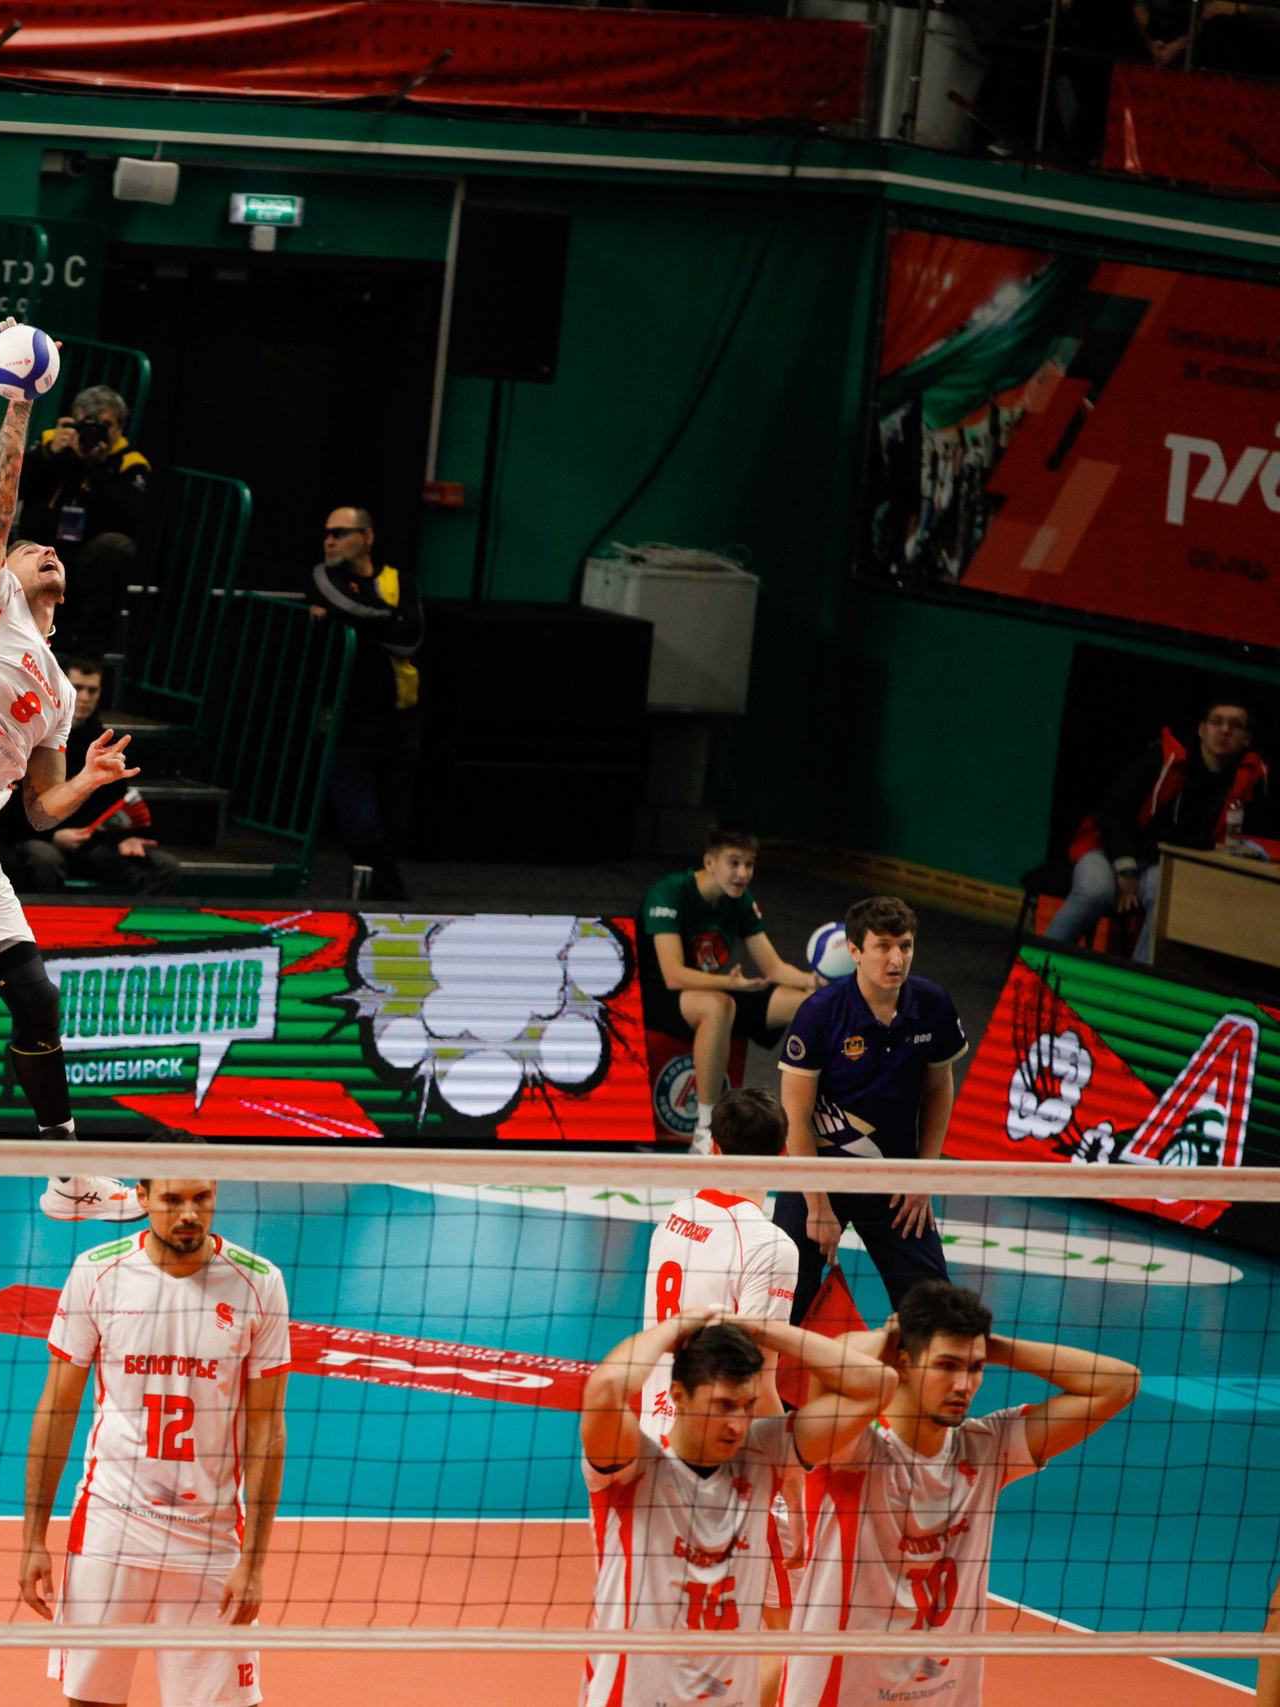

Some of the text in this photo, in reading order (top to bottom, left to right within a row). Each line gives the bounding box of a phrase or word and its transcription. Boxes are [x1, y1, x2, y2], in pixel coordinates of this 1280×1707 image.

[66, 1057, 184, 1086] ОСИБИРСК
[142, 1393, 196, 1462] 12
[237, 1662, 255, 1687] 12
